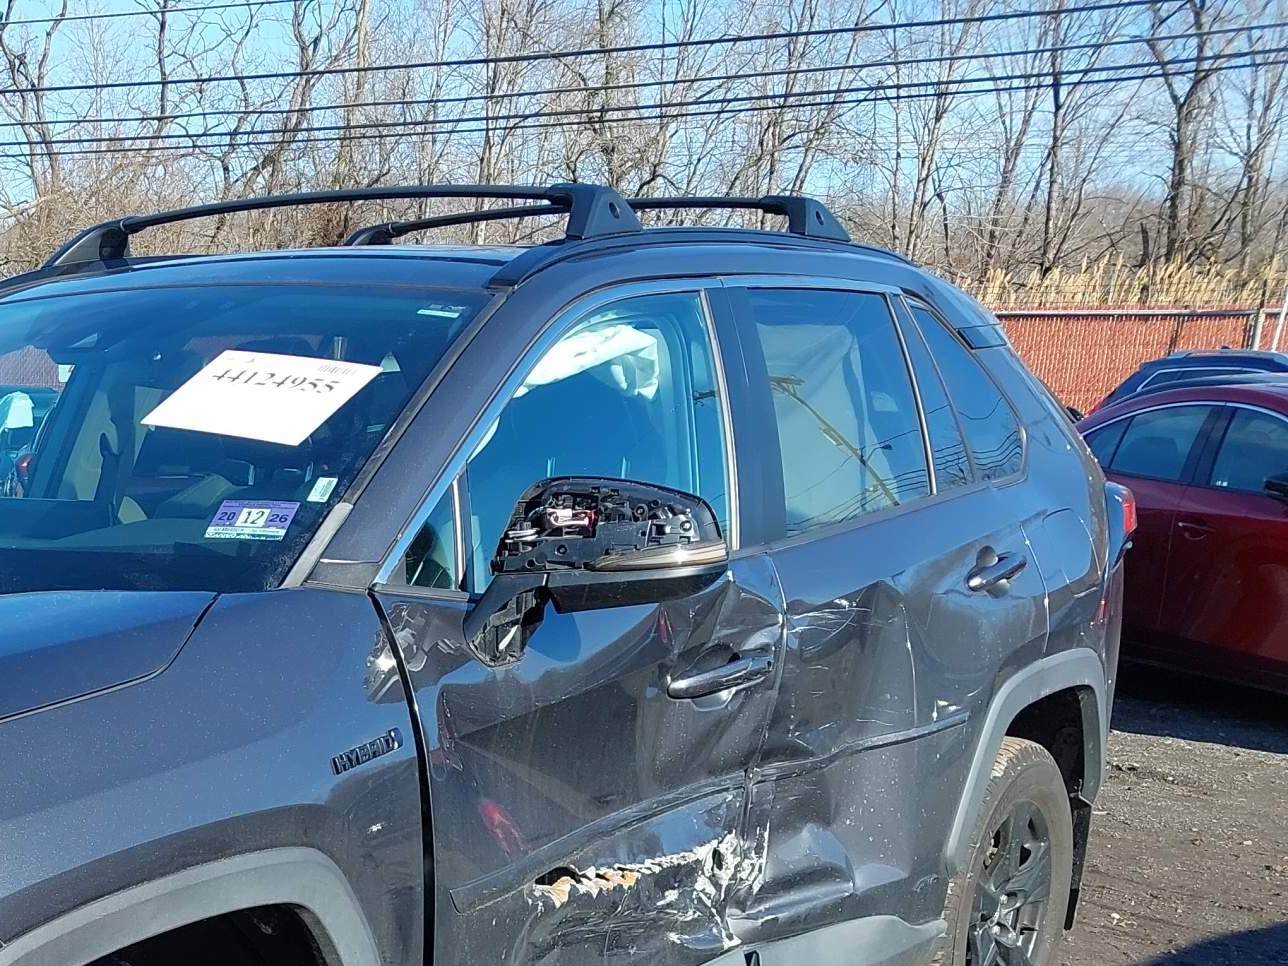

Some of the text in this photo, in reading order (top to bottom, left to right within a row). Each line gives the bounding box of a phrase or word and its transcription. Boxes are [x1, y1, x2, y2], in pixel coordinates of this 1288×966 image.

[212, 368, 340, 394] 44124955
[216, 510, 290, 525] 20 12 26
[329, 731, 400, 776] HYBRID
